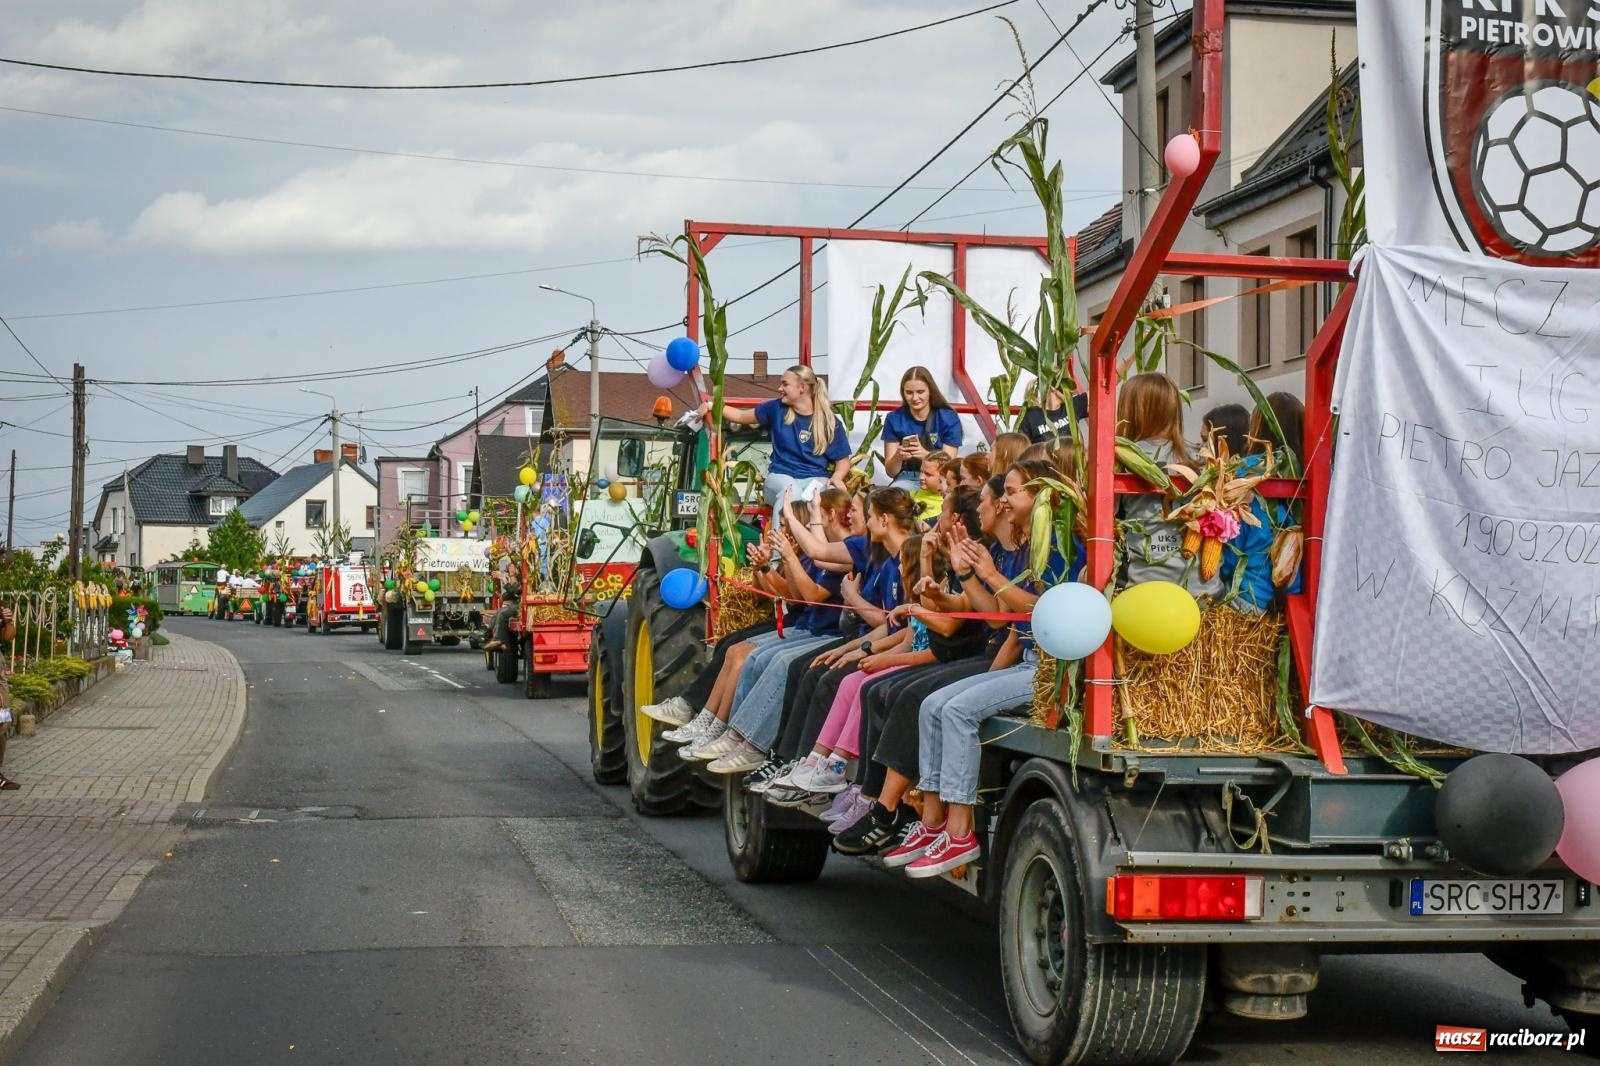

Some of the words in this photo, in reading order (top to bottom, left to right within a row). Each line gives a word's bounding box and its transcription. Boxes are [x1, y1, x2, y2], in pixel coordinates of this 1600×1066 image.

[1408, 273, 1571, 338] MECZ
[1517, 367, 1592, 424] LIG
[1377, 412, 1511, 481] PIETRO
[1157, 535, 1178, 543] UKS
[1354, 543, 1396, 600] W
[1412, 901, 1422, 909] PL
[1430, 883, 1480, 911] SRC
[1491, 883, 1557, 911] SH37
